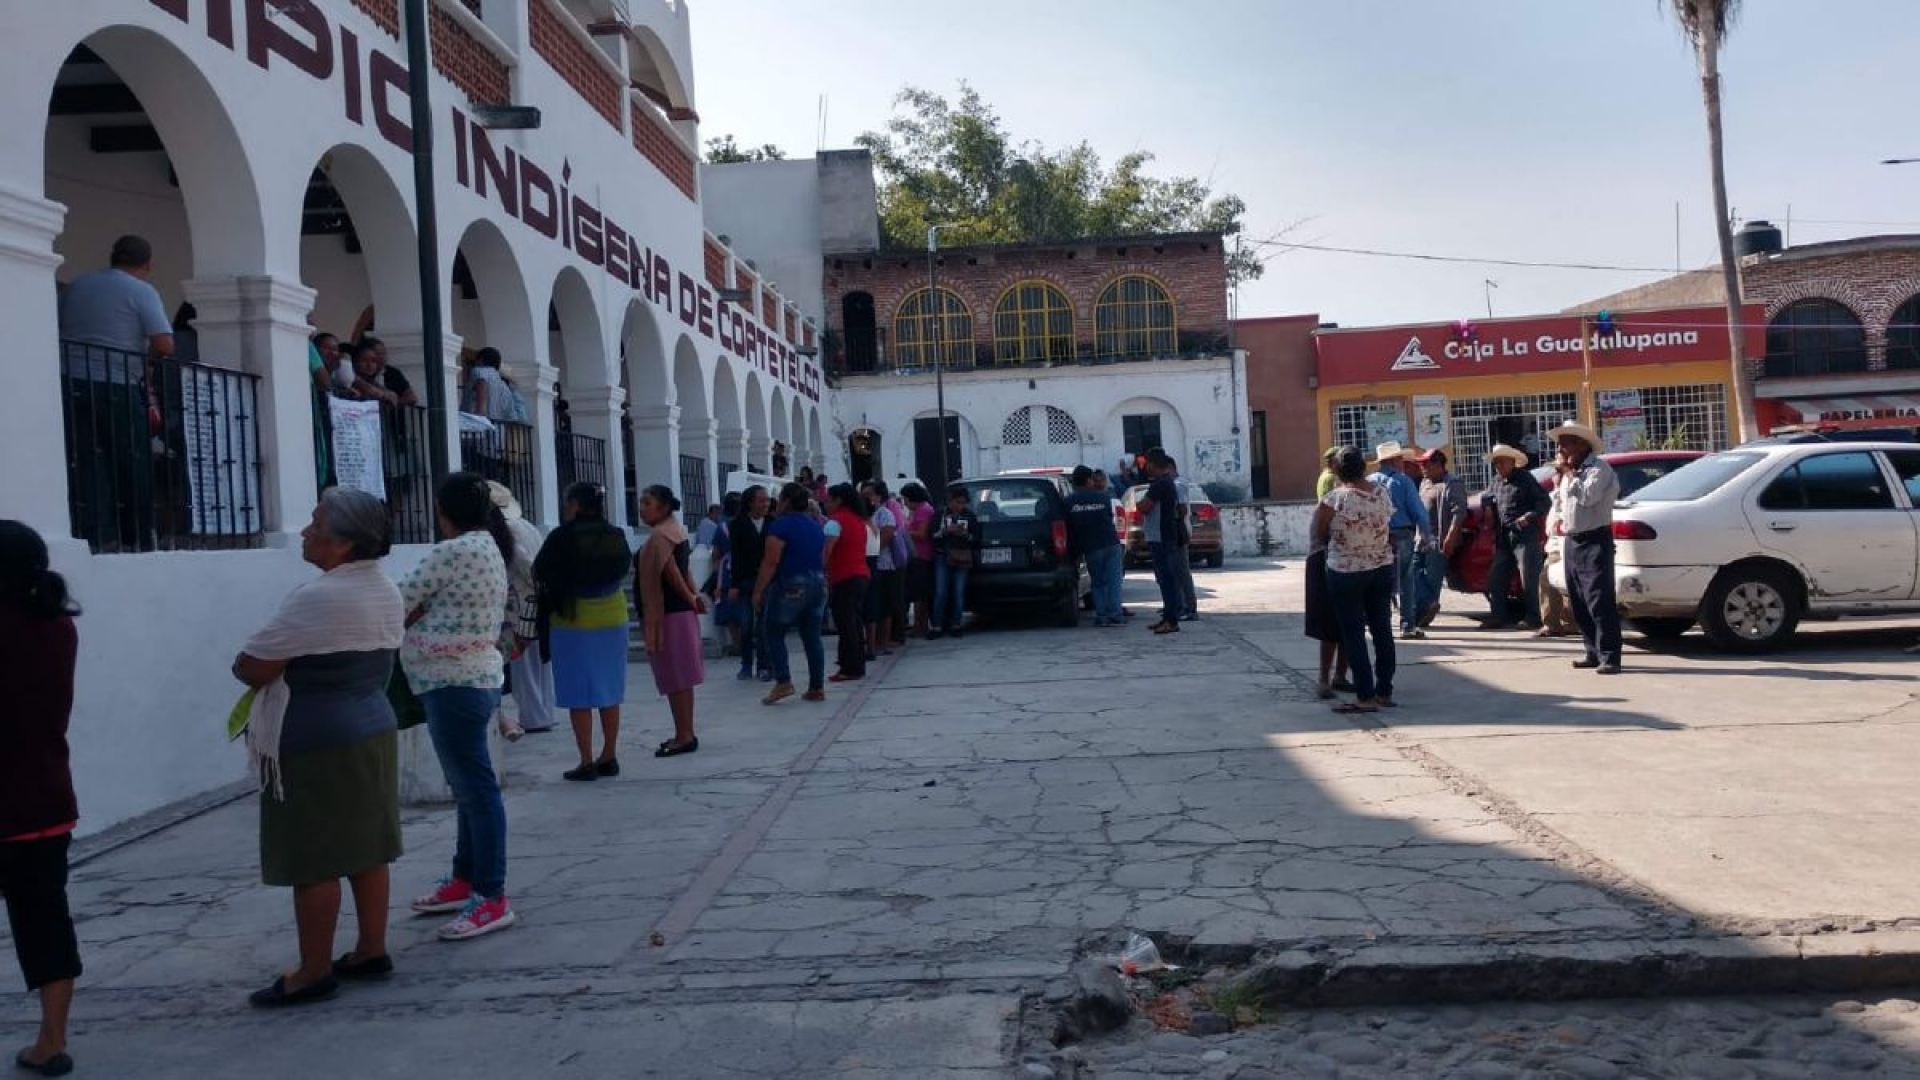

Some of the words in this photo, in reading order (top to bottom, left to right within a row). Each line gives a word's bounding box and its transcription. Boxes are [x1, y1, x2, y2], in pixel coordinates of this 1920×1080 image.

[679, 270, 714, 340] DE
[717, 299, 820, 403] COATETELCO
[1444, 339, 1494, 363] Caja
[1501, 337, 1529, 356] La
[1535, 330, 1699, 353] Guadalupana
